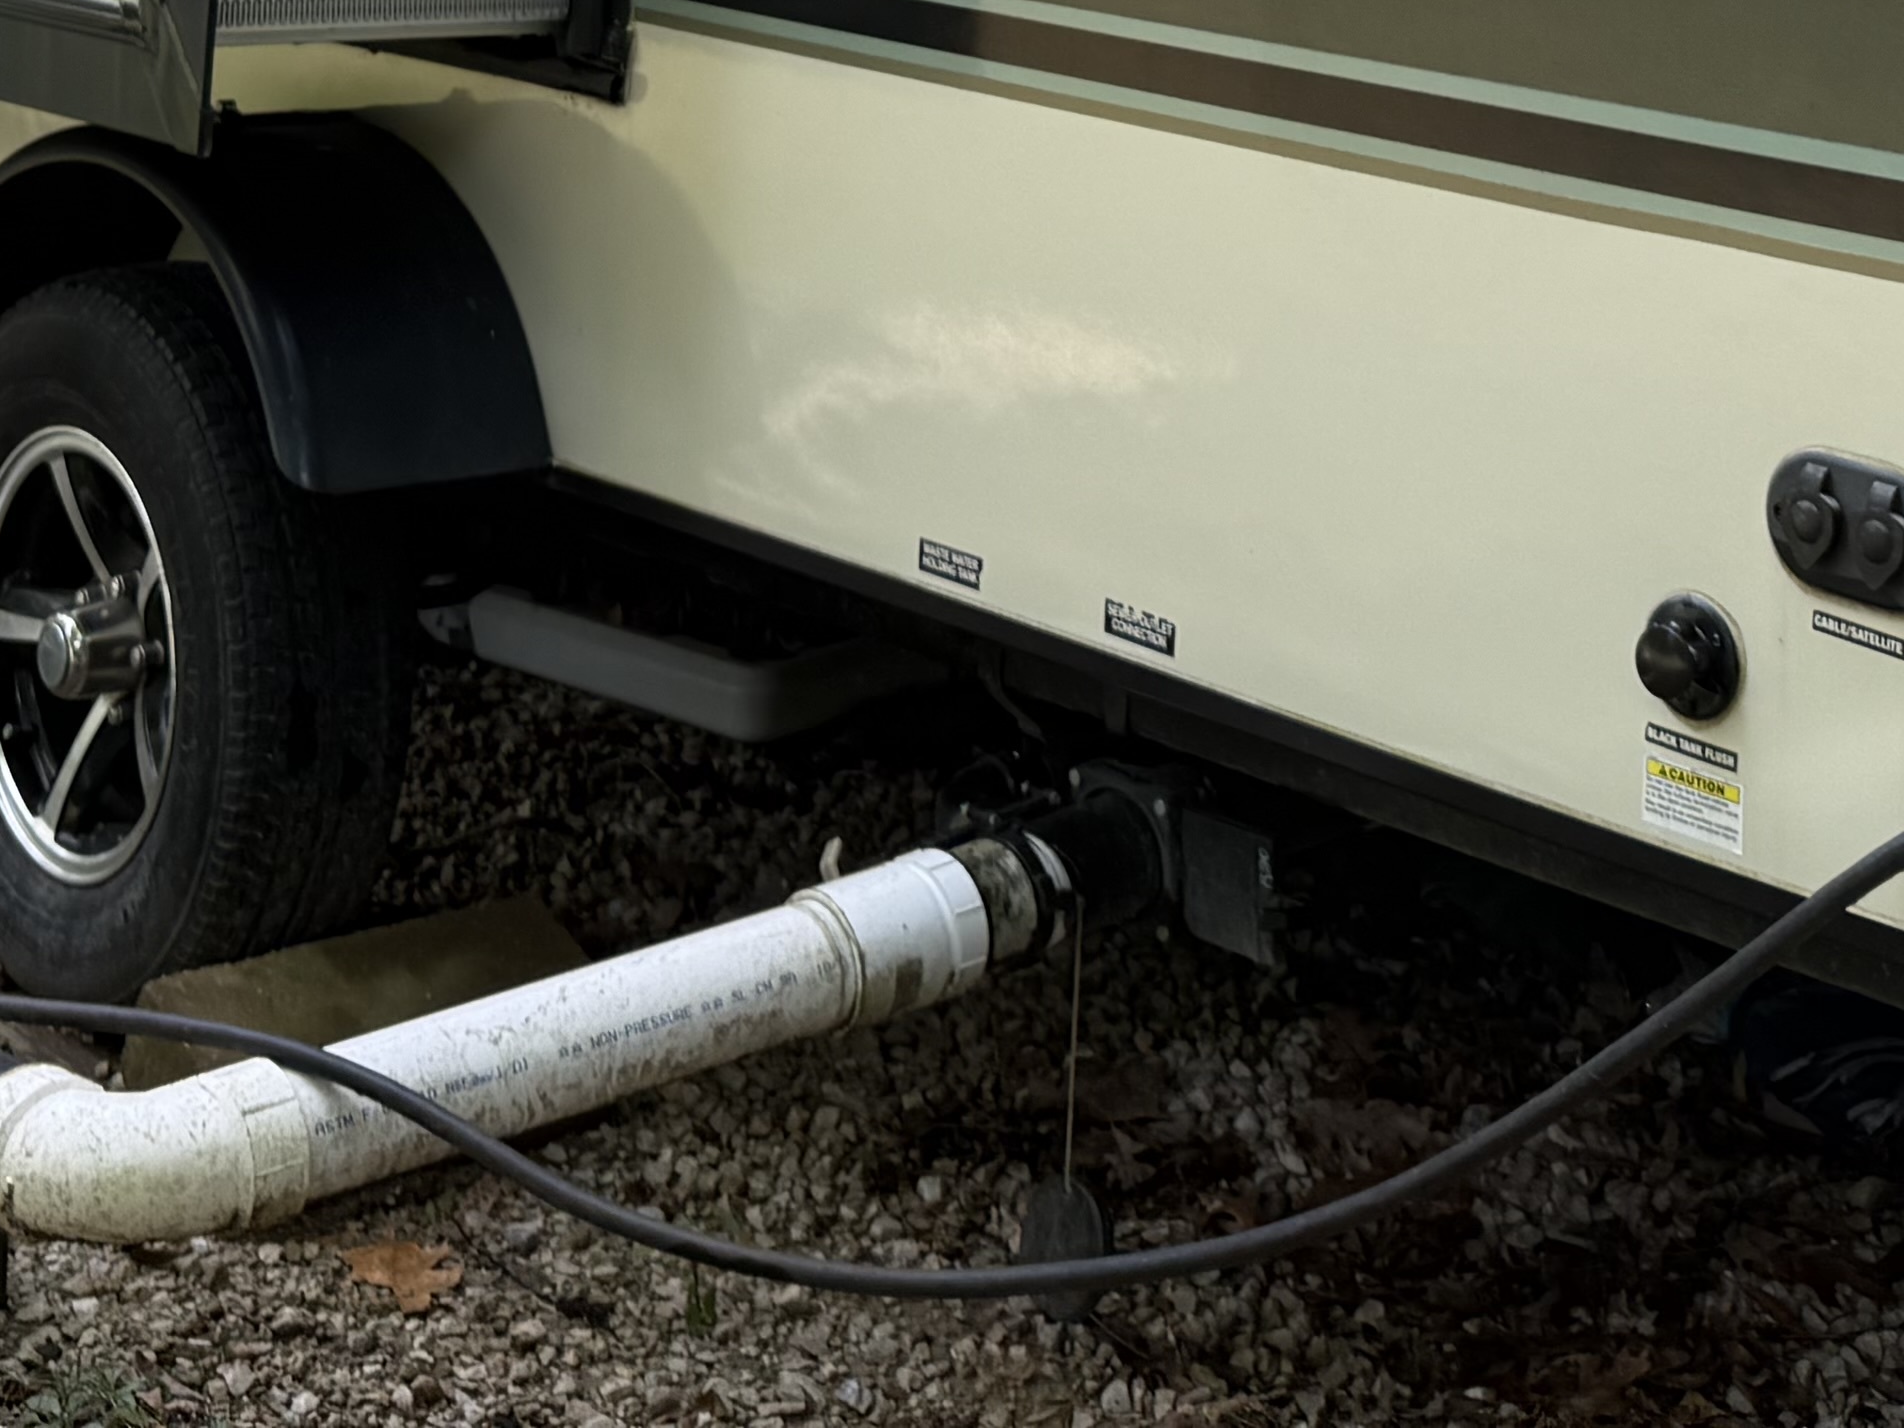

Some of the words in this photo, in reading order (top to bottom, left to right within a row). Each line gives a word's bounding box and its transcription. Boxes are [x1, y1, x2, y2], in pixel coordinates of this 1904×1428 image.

[1814, 613, 1904, 656] CABLE/SATELLITE
[1647, 725, 1678, 750] BLACK
[1678, 737, 1704, 757] TANK
[1704, 746, 1735, 768] FLUSH
[1668, 768, 1726, 796] CAUTION
